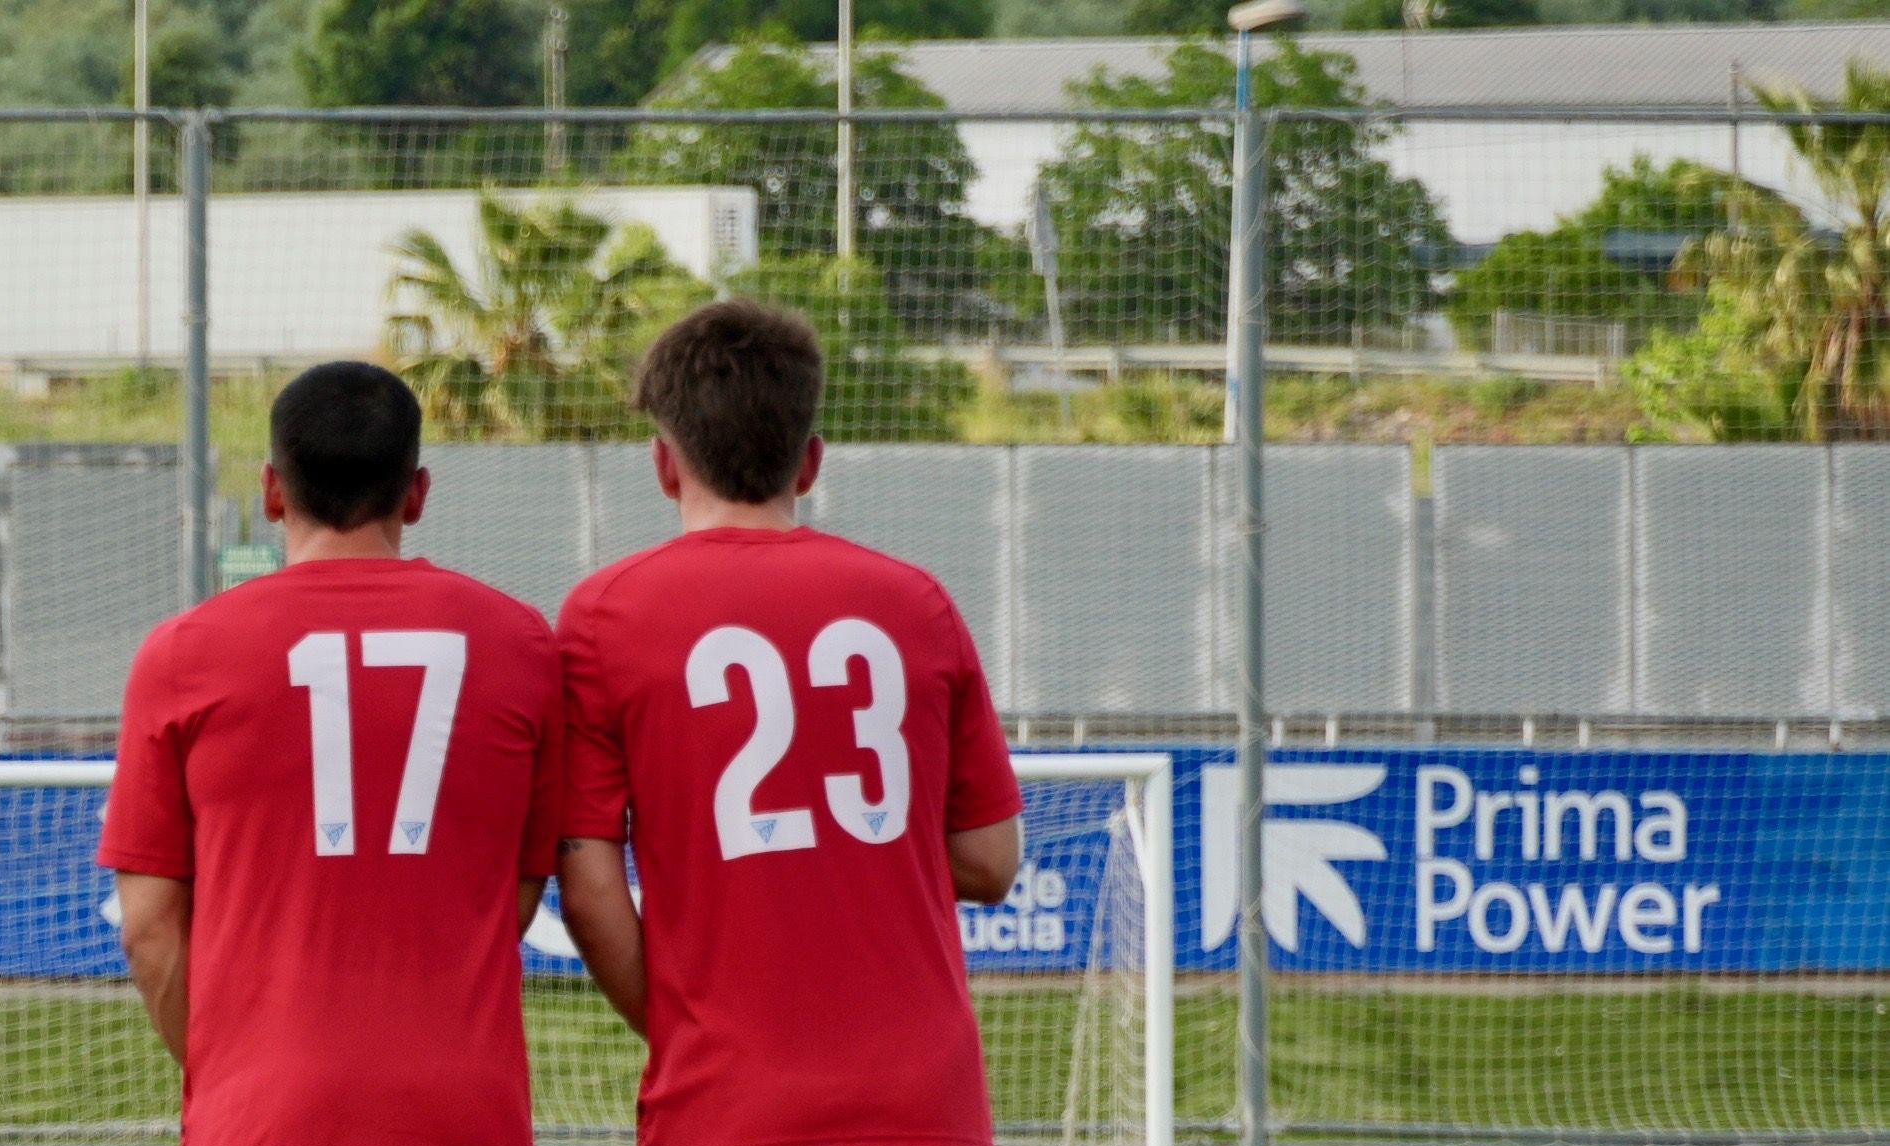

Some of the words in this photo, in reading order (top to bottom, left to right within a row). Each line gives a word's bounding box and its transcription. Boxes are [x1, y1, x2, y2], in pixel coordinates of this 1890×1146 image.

[287, 630, 468, 856] 17
[684, 618, 910, 861] 23
[1416, 765, 1688, 862] Prima
[1416, 858, 1720, 953] Power
